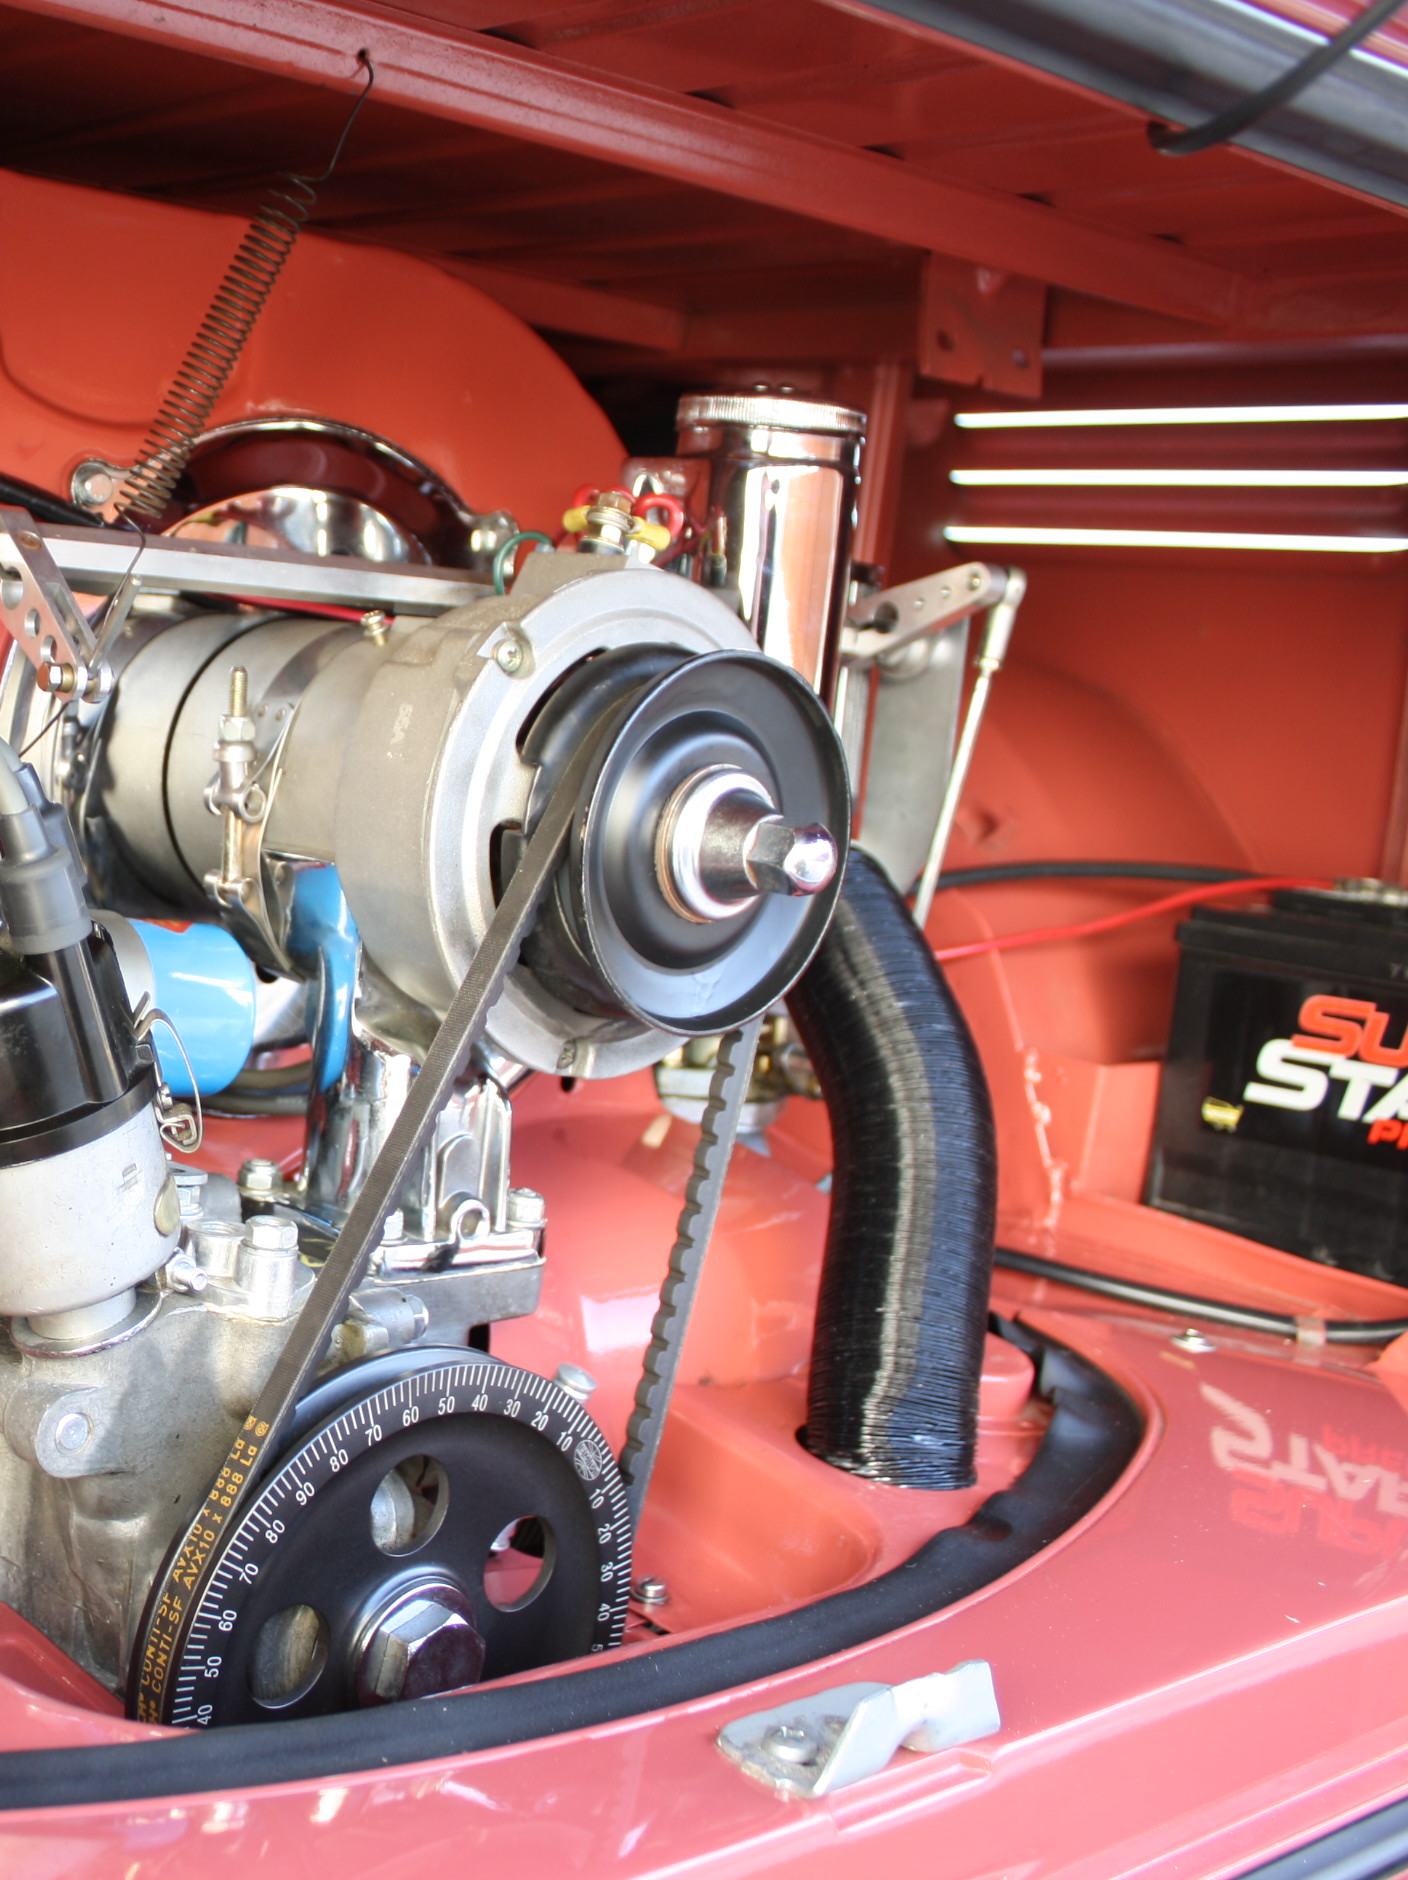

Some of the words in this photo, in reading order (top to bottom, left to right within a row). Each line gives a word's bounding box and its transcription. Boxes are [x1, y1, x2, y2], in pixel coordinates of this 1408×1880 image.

[438, 1396, 455, 1415] 50
[471, 1394, 488, 1412] 40
[503, 1399, 521, 1418] 30
[402, 1406, 419, 1427] 60
[531, 1411, 549, 1431] 20
[365, 1424, 382, 1446] 70
[556, 1431, 573, 1452] 10
[329, 1449, 349, 1473] 80
[295, 1481, 315, 1505] 90
[589, 1488, 605, 1509] 10
[265, 1519, 285, 1544] 80
[597, 1523, 612, 1544] 20
[152, 1596, 184, 1693] CONTI-SF
[183, 1530, 215, 1590] AVX10
[212, 1513, 223, 1524] x
[220, 1473, 244, 1507] 888
[240, 1445, 258, 1466] La
[238, 1563, 259, 1584] 70
[600, 1561, 614, 1582] 30
[218, 1610, 238, 1632] 60
[597, 1603, 611, 1622] 40
[203, 1656, 223, 1678] 50
[196, 1704, 213, 1725] 40
